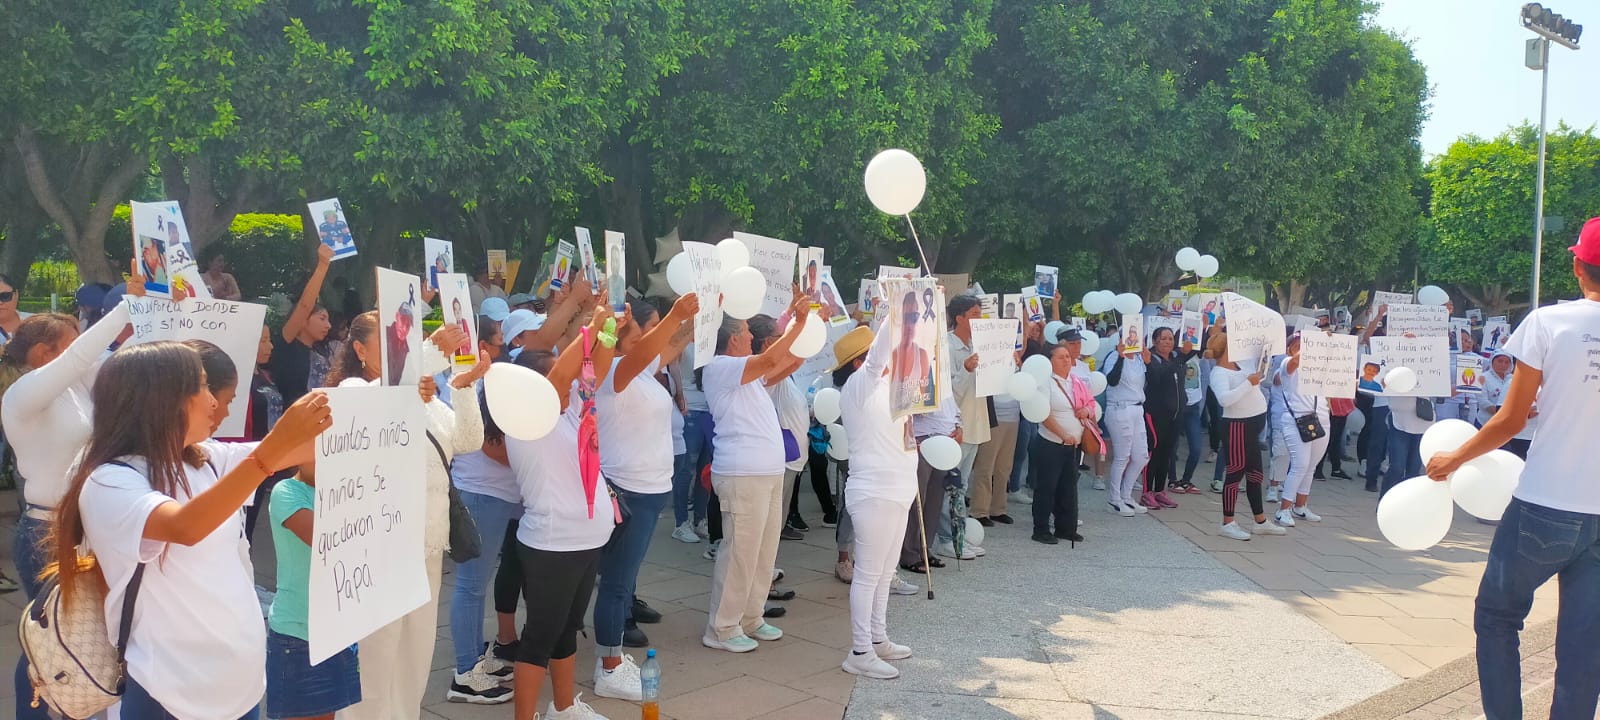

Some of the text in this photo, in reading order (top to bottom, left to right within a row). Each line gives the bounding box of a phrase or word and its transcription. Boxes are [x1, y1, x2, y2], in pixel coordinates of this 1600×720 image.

[378, 420, 410, 447] niños
[328, 476, 365, 512] niñas
[318, 514, 374, 567] quedaron
